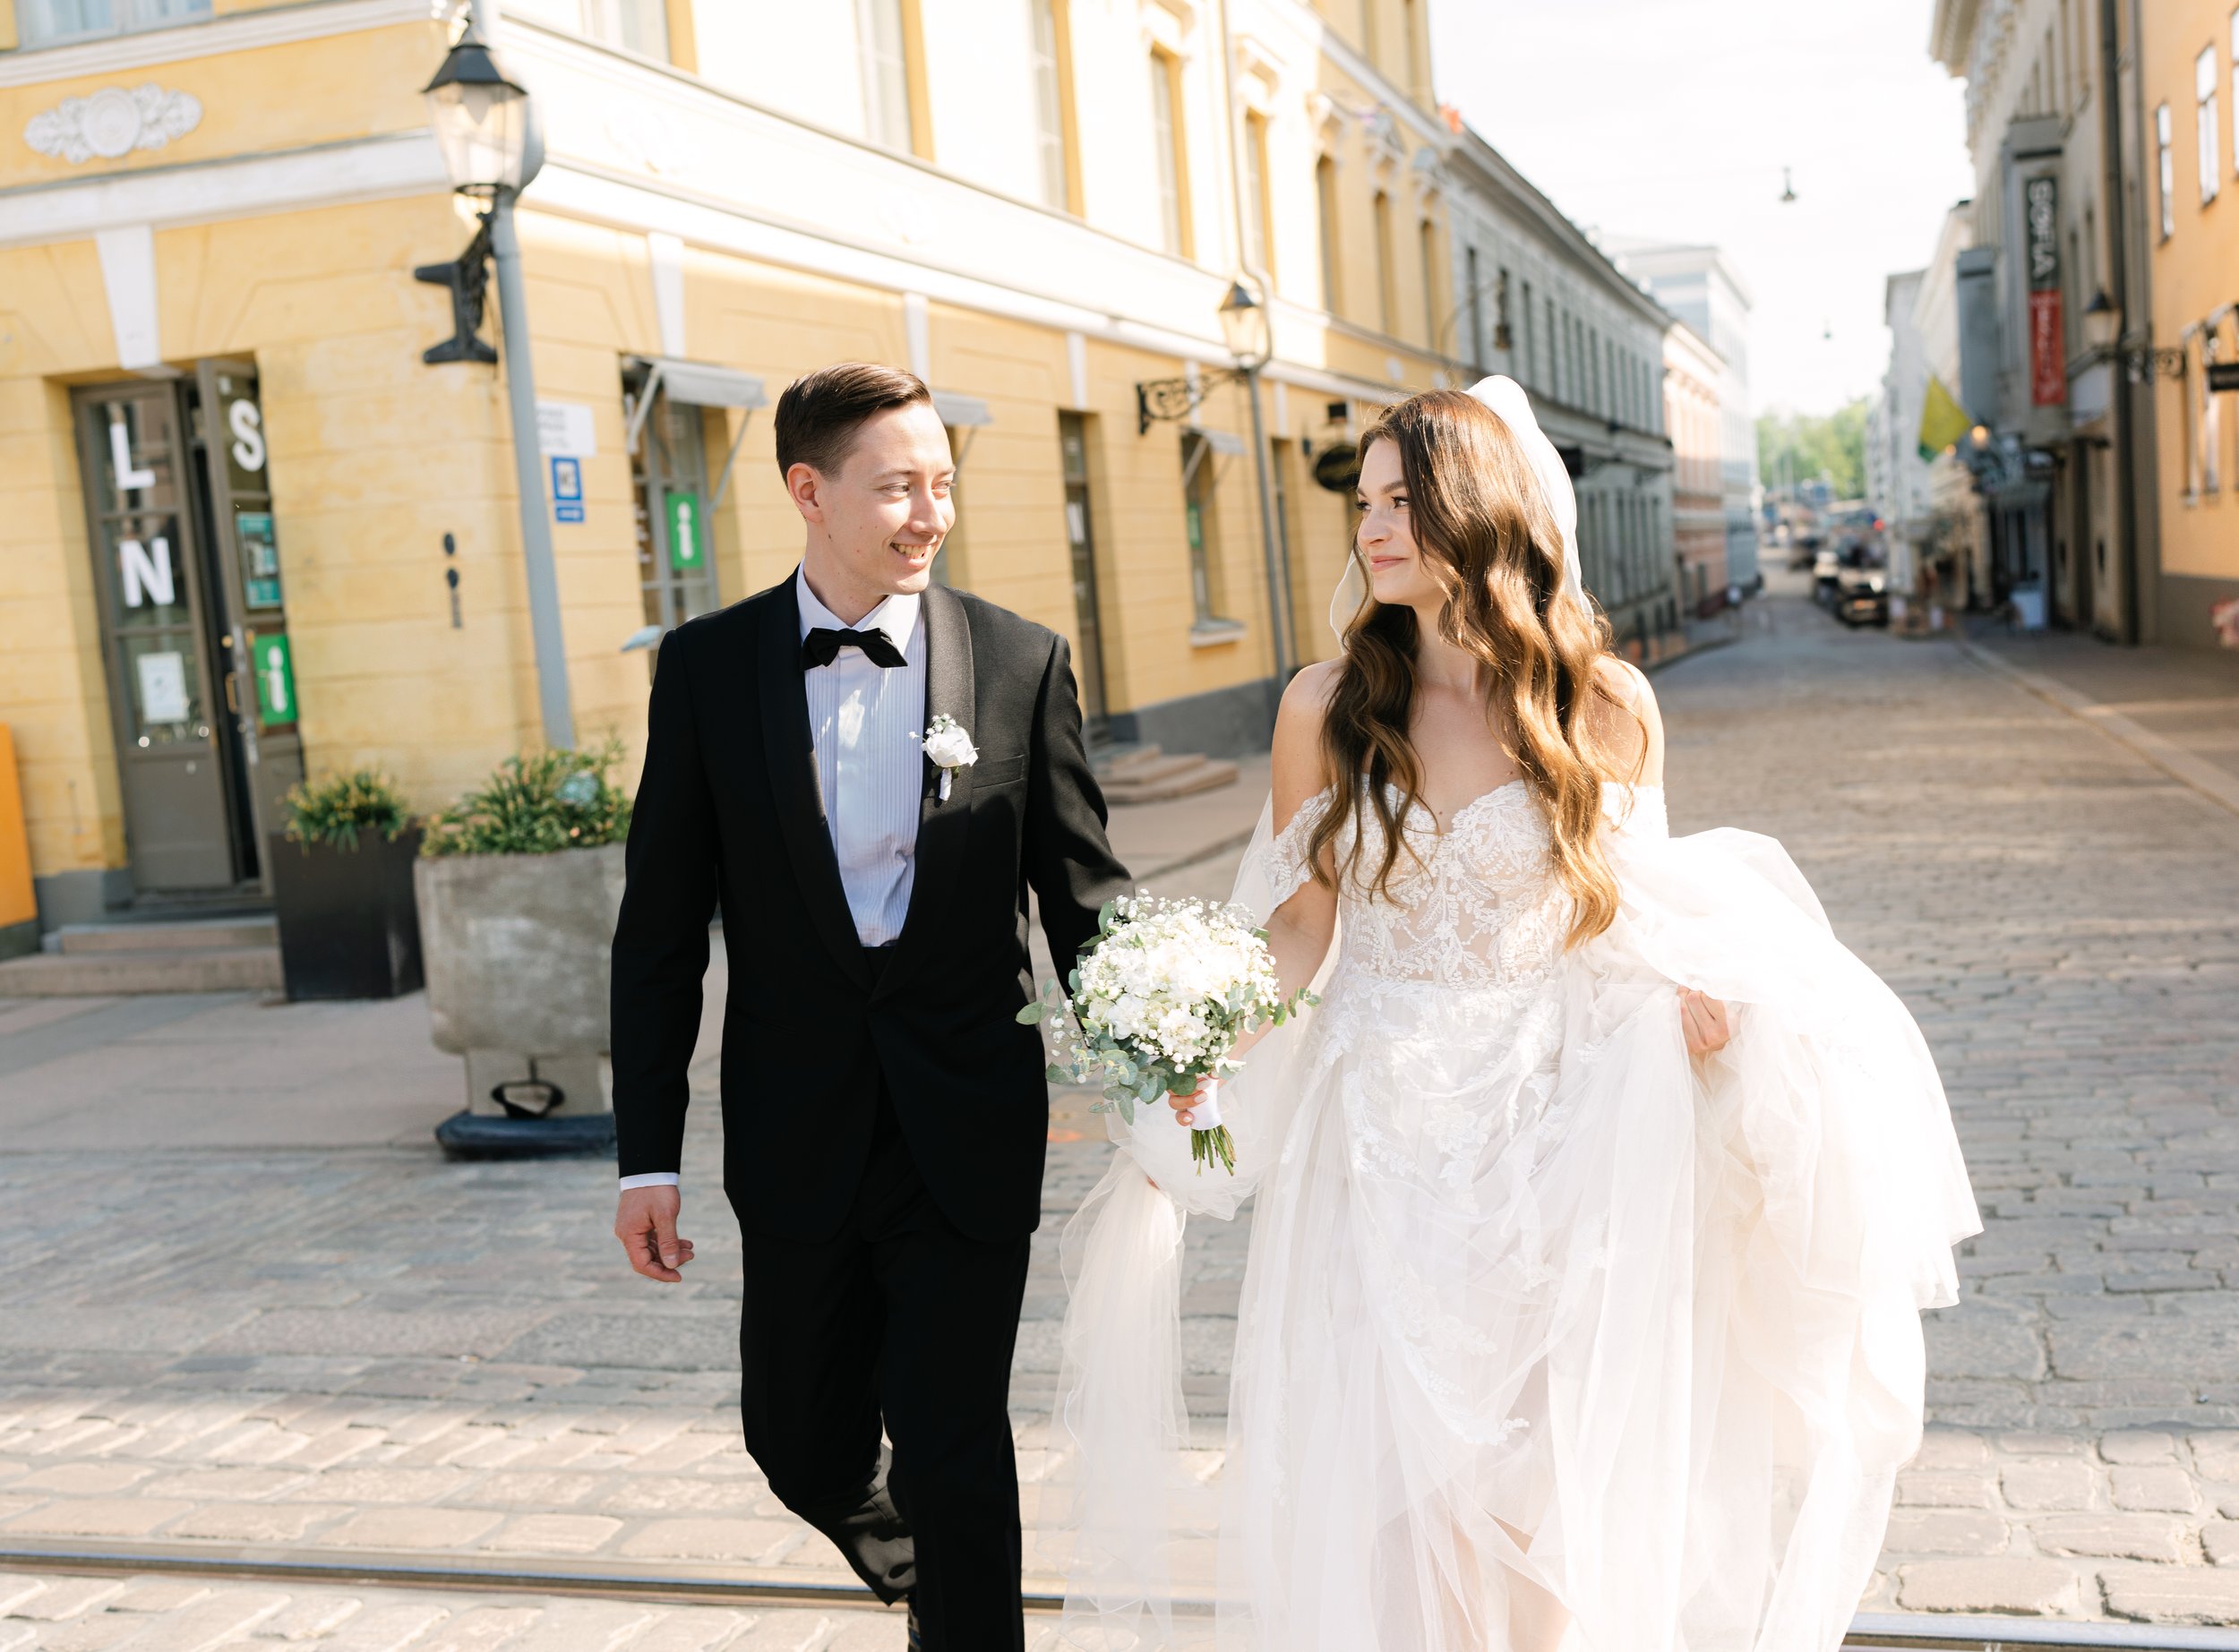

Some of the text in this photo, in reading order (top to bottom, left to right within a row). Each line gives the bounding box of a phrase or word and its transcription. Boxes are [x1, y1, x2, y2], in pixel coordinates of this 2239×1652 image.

[108, 422, 156, 491] L
[228, 398, 266, 472] S
[118, 536, 176, 608] N
